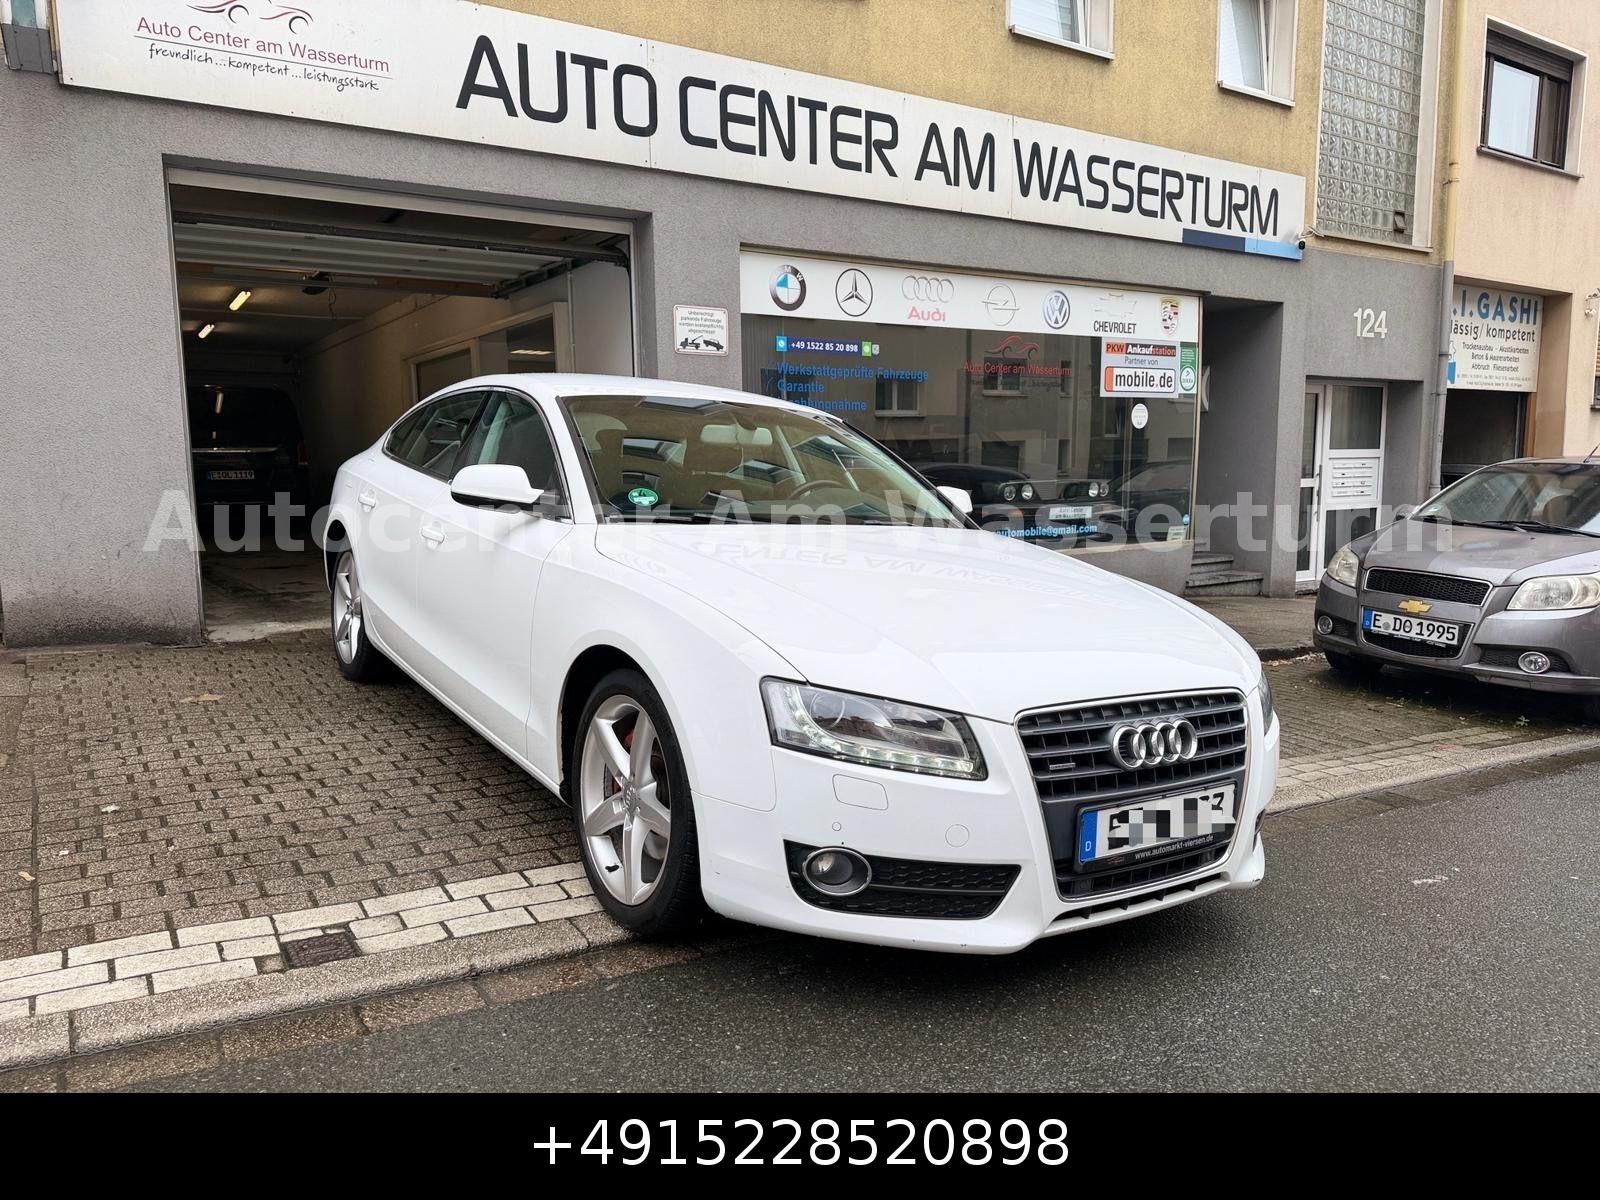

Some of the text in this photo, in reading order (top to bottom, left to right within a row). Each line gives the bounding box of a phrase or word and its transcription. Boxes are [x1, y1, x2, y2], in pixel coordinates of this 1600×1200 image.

[136, 16, 390, 73] Auto Center am Wasserturm
[455, 34, 1279, 237] AUTO CENTER AM WASSERTURM
[907, 305, 946, 322] Audi
[1093, 320, 1137, 335] CHEVROLET
[1353, 307, 1388, 339] 124
[1486, 323, 1536, 343] kompetent
[791, 341, 859, 353] +49 1522 85 20 898
[1106, 343, 1125, 353] PKW
[1127, 344, 1176, 356] Ankaufstation
[984, 362, 1011, 374] Center
[1013, 366, 1025, 374] am
[1027, 363, 1072, 376] Wasserturm
[1124, 356, 1147, 365] Partner
[776, 361, 929, 383] Werkstattgeprüfte Fahrzeuge
[1115, 370, 1173, 388] mobile.de
[777, 379, 825, 393] Garantie
[1373, 613, 1382, 629] E
[1415, 620, 1457, 641] 1995
[1085, 840, 1092, 851] D
[1134, 834, 1214, 860] www.automarkt-viersen.de
